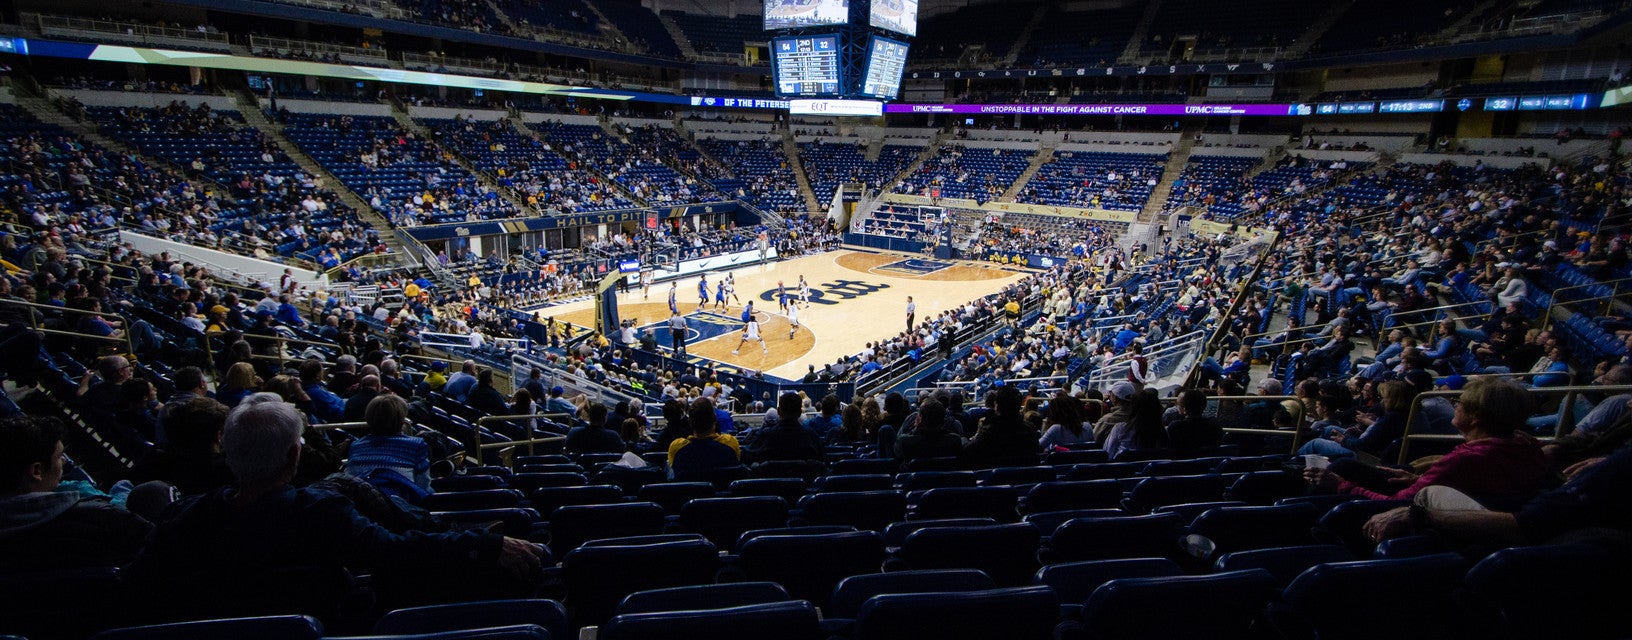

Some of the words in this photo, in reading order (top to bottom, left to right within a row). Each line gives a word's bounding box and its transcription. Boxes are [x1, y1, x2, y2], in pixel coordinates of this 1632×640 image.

[724, 98, 735, 106] OF
[738, 99, 753, 107] THE
[755, 100, 790, 109] PETERSE
[812, 102, 828, 112] EQT
[1388, 103, 1413, 112] 17:13
[1492, 100, 1507, 109] 32
[557, 218, 591, 227] HAIL
[598, 214, 615, 223] TO
[622, 212, 642, 221] PIT
[760, 280, 890, 305] Pitt
